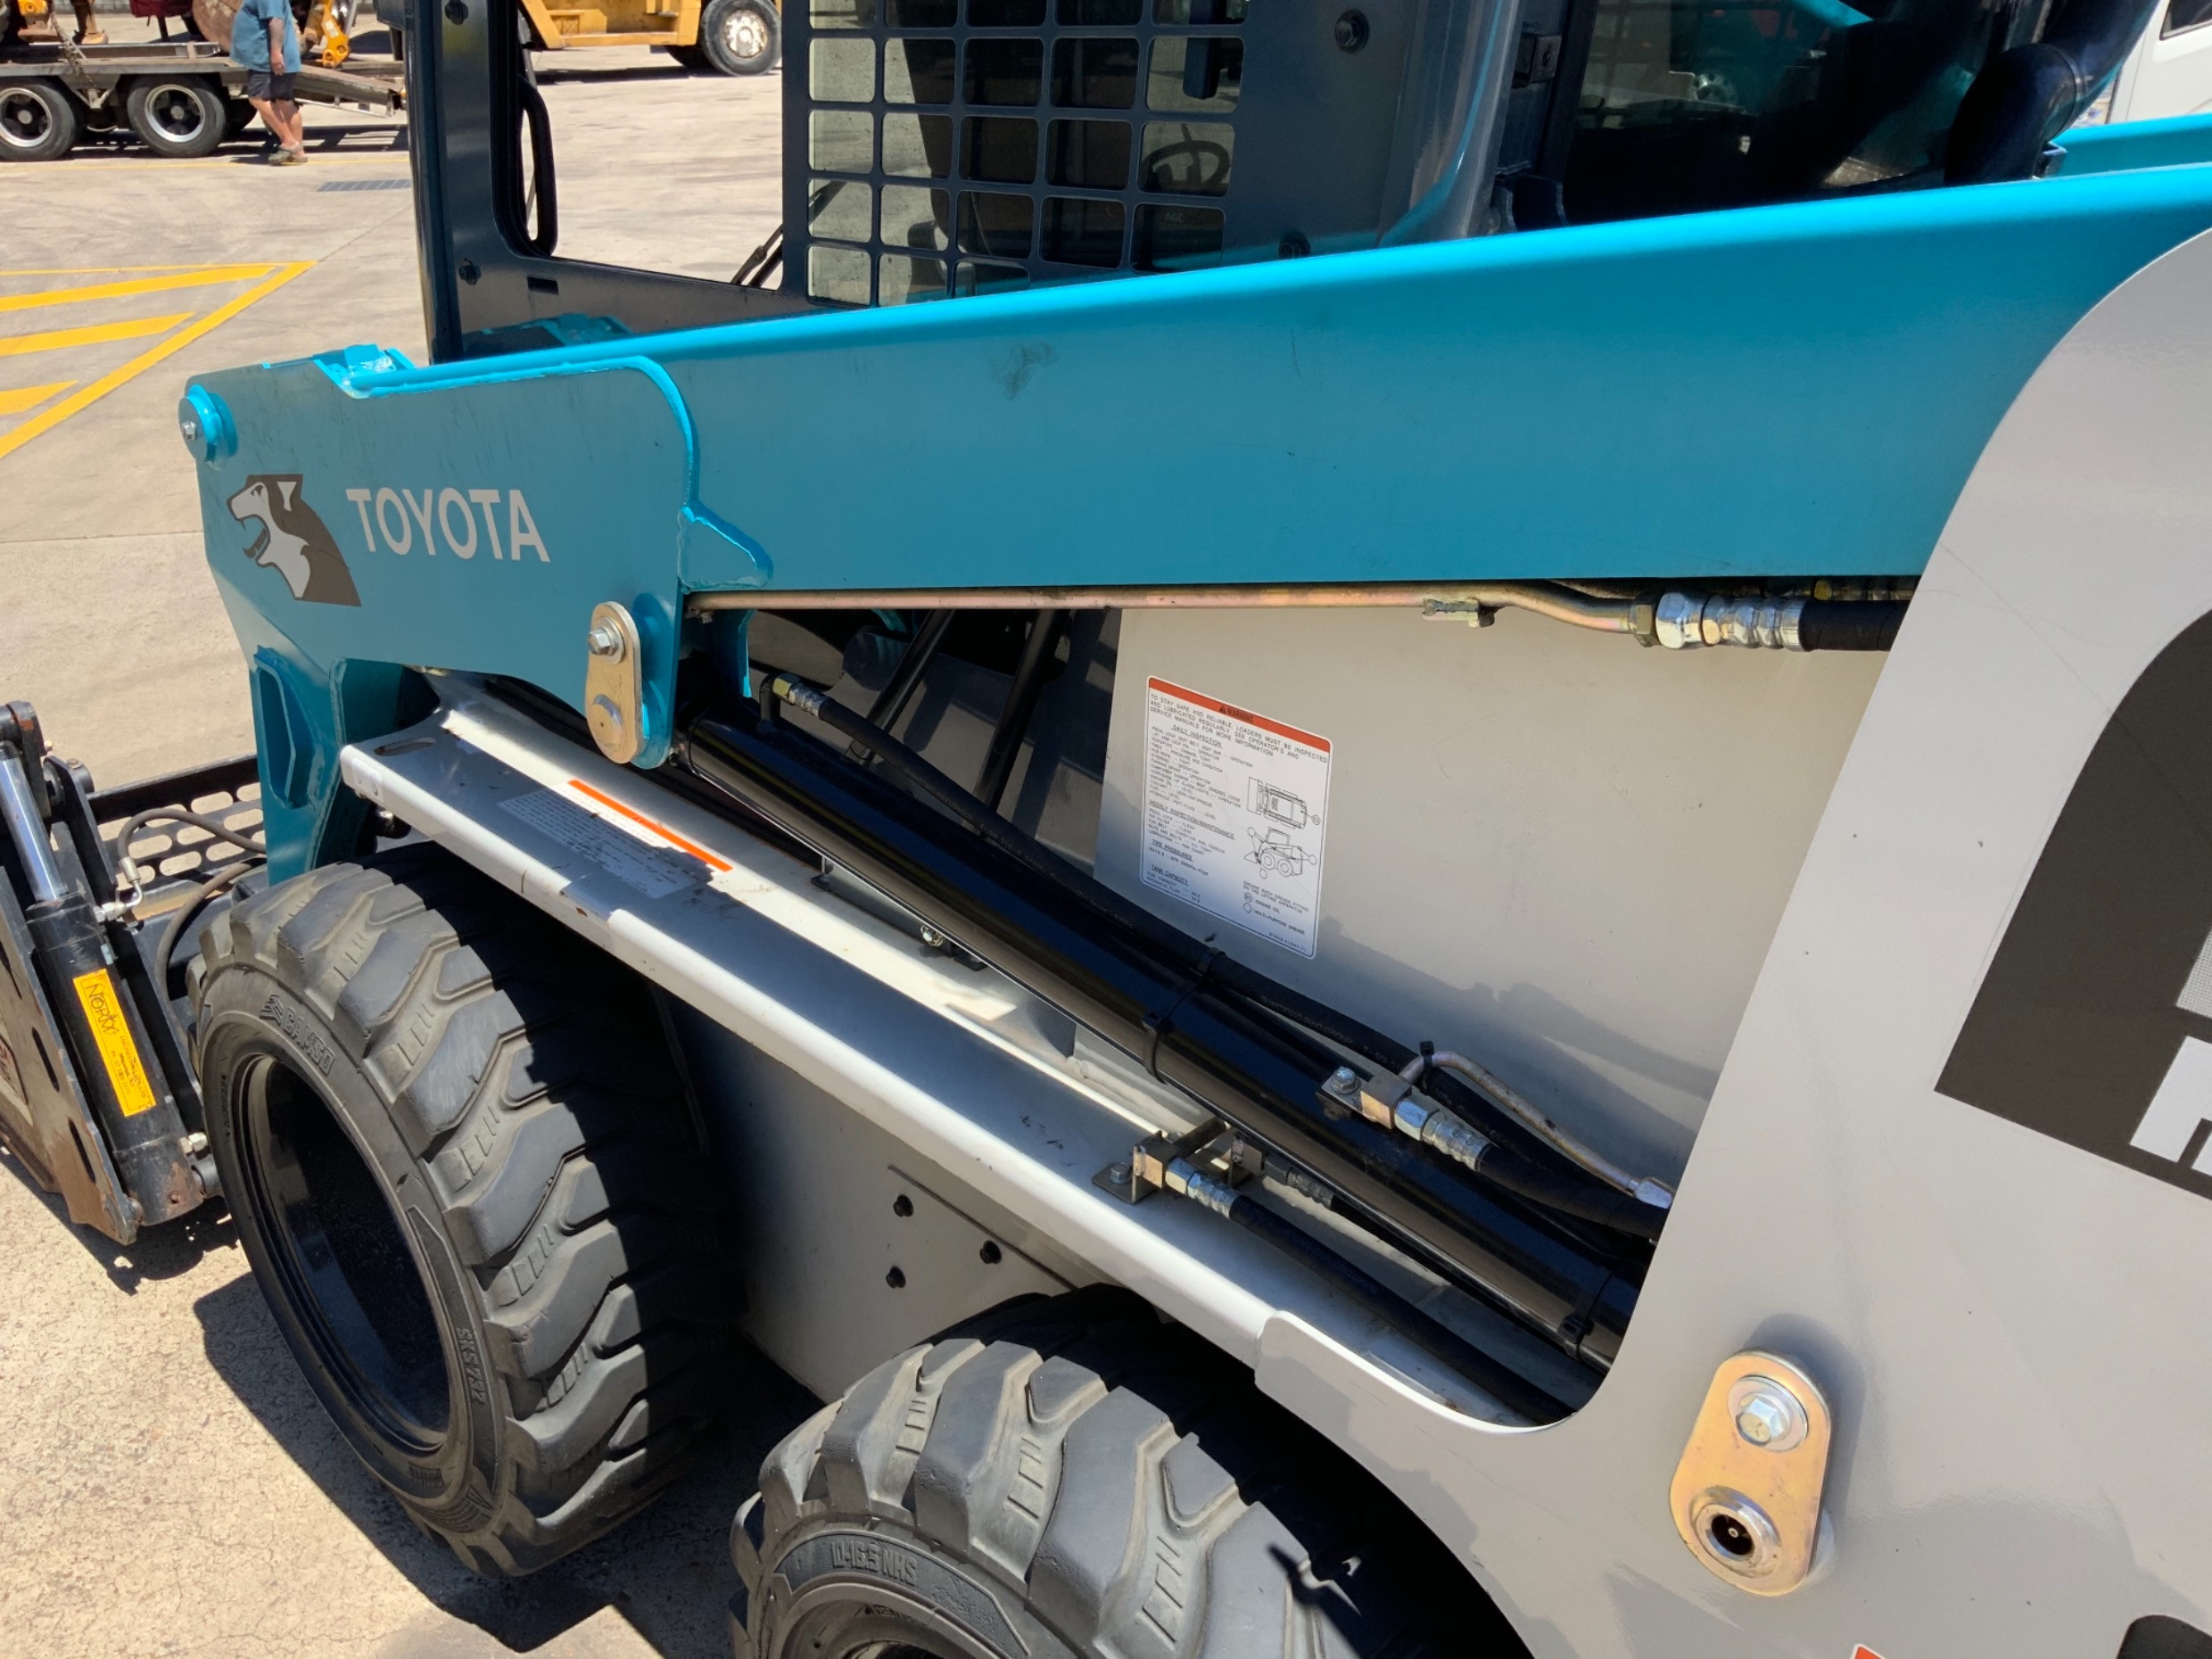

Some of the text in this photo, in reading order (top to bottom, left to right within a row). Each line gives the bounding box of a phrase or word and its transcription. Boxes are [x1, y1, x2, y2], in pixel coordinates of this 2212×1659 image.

[345, 487, 551, 563] TOYOTA
[1150, 706, 1172, 720] SERVICE
[1175, 715, 1201, 730] MANUALS
[1217, 730, 1232, 742] MORE
[1235, 738, 1274, 757] INFORMATION
[1160, 697, 1174, 707] STAY
[1176, 703, 1189, 714] SAFE
[1236, 724, 1262, 739] LOADERS
[1266, 735, 1281, 746] MUST
[1294, 746, 1327, 763] INSPECTED
[1164, 706, 1196, 722] LUBRICATED
[1190, 731, 1222, 748] INSPECTION
[285, 1006, 335, 1077] CAMSO
[881, 1546, 918, 1587] NHS
